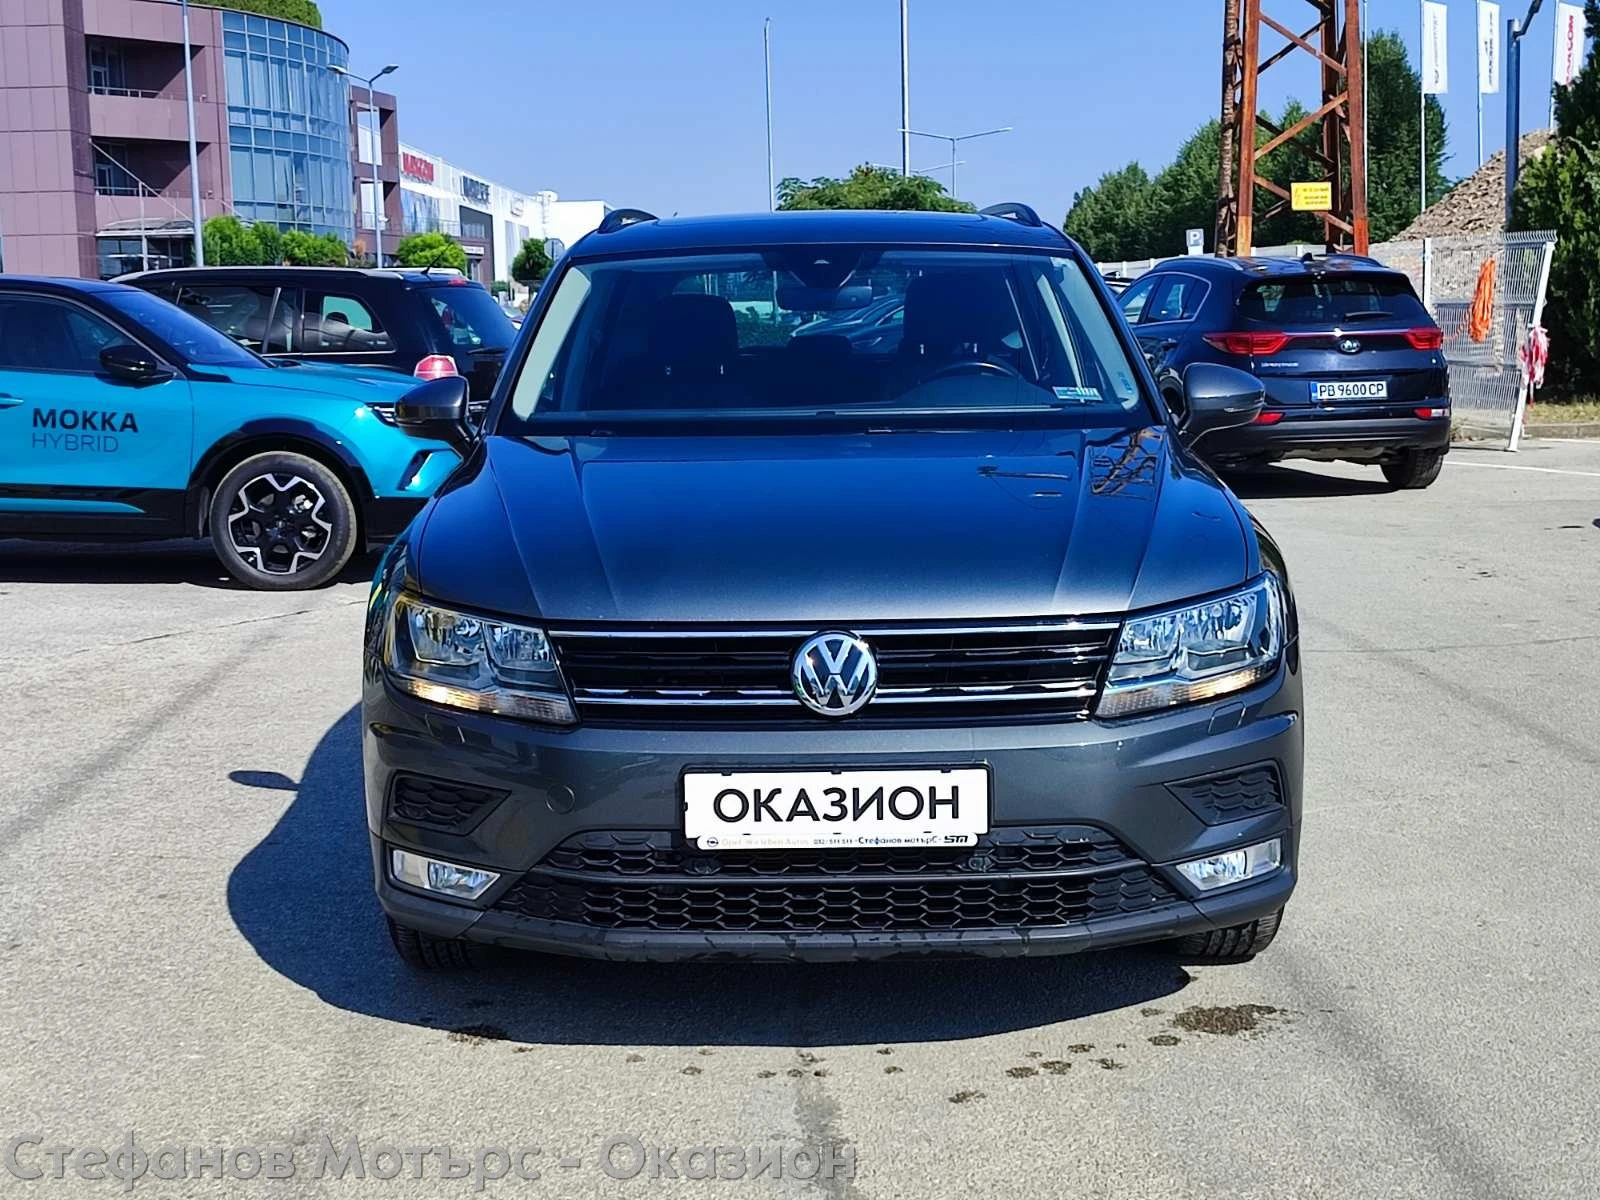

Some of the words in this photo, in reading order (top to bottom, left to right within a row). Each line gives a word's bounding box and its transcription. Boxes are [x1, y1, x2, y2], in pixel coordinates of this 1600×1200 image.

[1190, 231, 1201, 245] P
[1319, 384, 1335, 397] PB
[1339, 384, 1367, 396] 9600
[1369, 383, 1384, 395] CP
[33, 408, 139, 433] MOKKA
[32, 432, 119, 453] HYBRID
[713, 785, 959, 823] ОКАЗИОН
